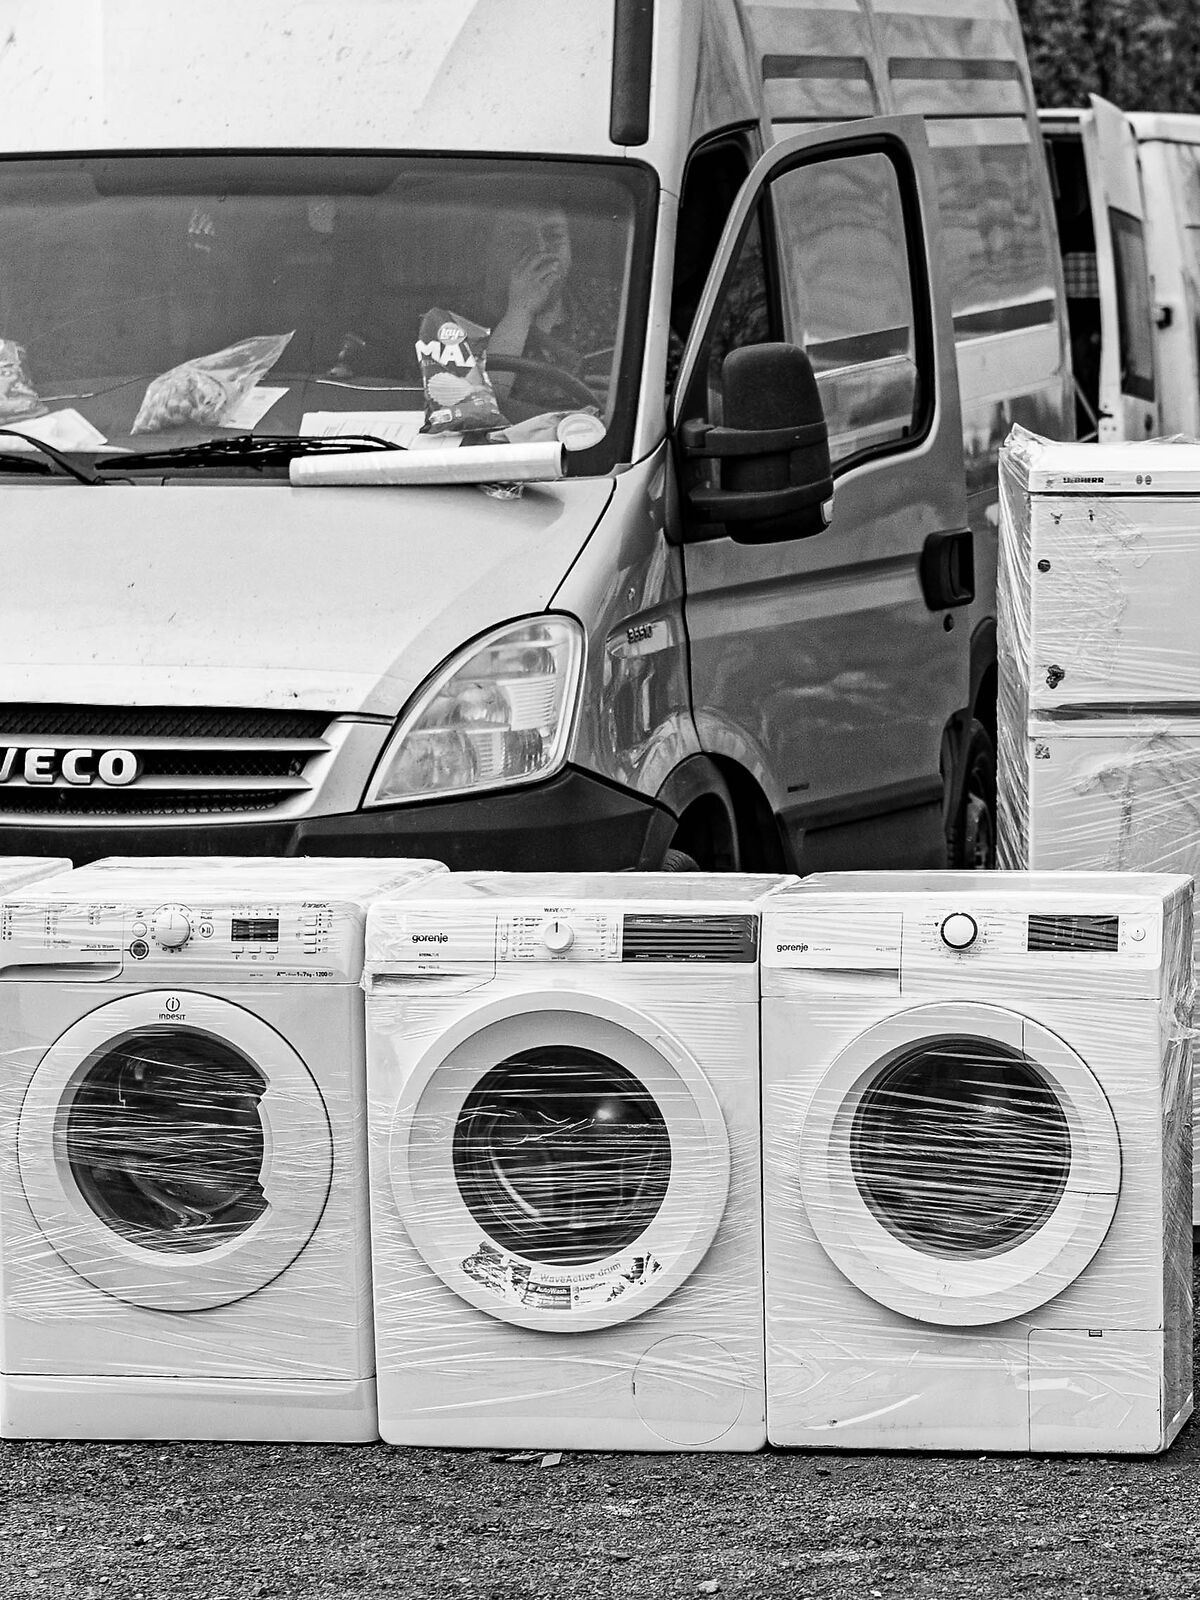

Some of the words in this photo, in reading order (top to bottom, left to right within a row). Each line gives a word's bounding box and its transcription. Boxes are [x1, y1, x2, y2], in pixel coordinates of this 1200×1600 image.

[412, 932, 449, 944] gorenje
[776, 943, 809, 953] gorenje
[540, 1273, 596, 1284] WaveActive
[598, 1262, 622, 1277] drum
[536, 1285, 568, 1295] AutoWash
